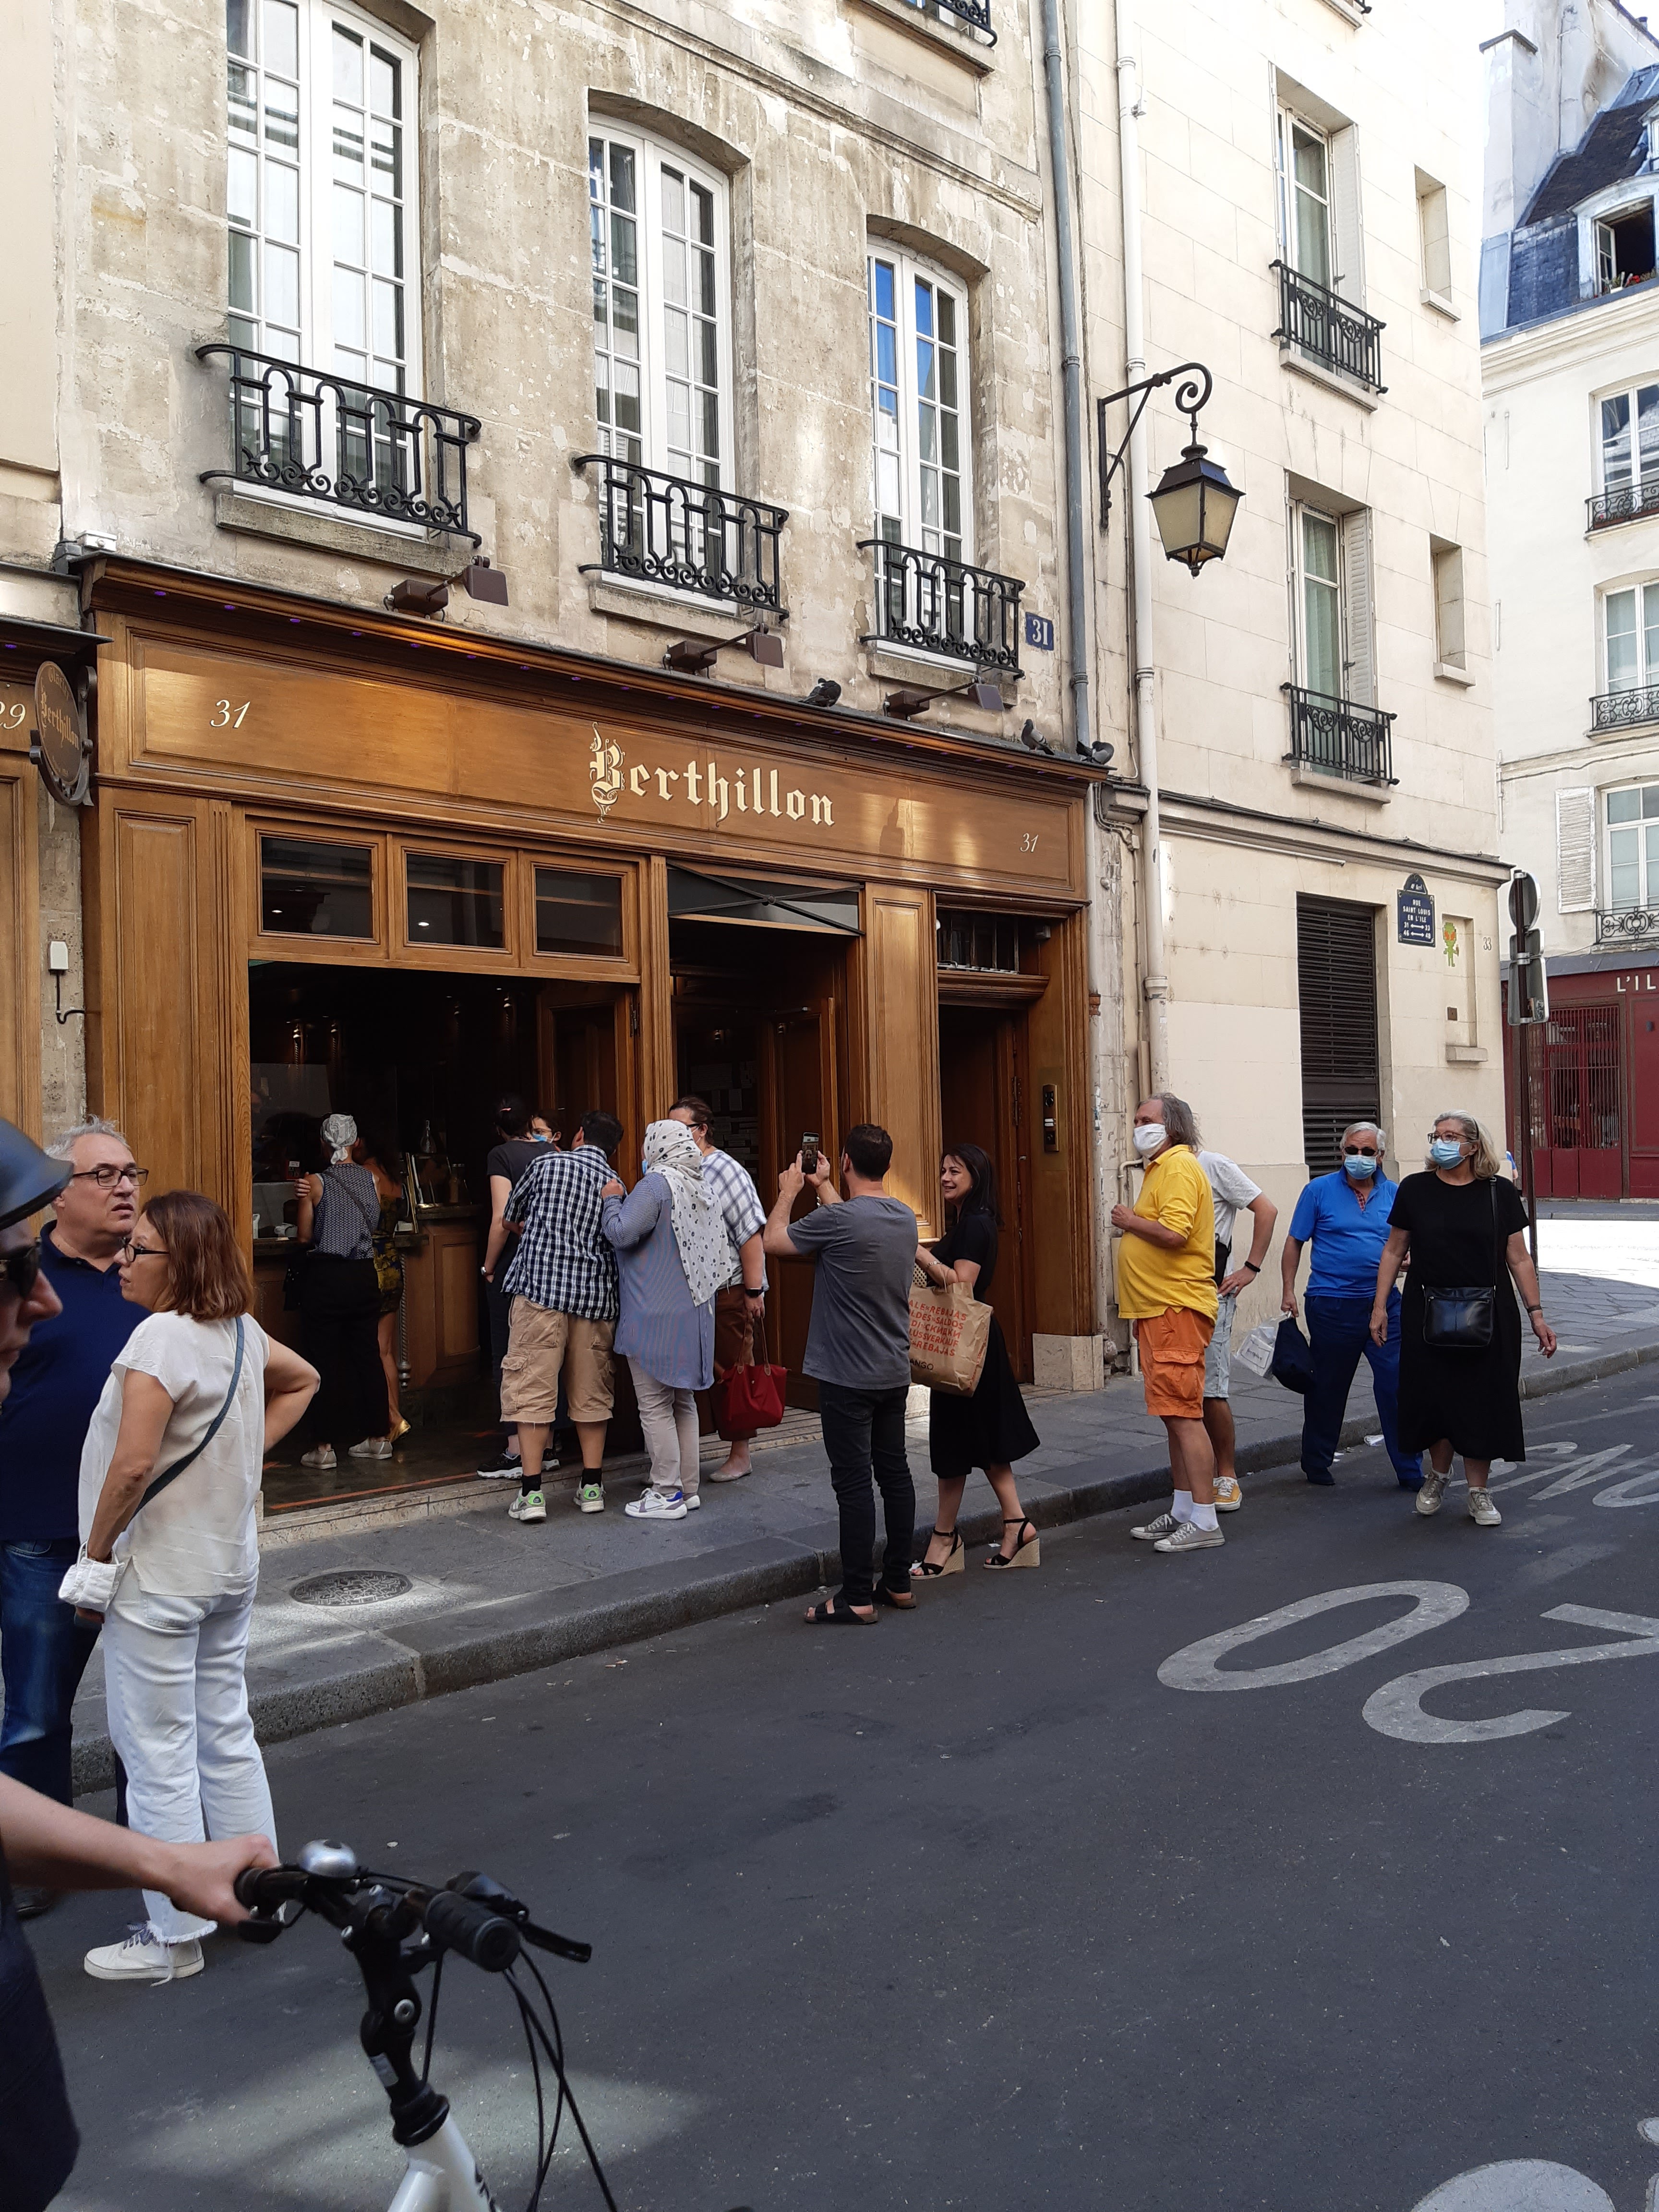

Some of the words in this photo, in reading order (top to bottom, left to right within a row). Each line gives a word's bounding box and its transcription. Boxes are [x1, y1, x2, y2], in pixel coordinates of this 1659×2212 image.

[1031, 618, 1050, 647] 31
[40, 677, 79, 750] Berthillon
[210, 699, 251, 729] 31
[589, 721, 836, 828] Berthillon
[1020, 832, 1039, 853] 31
[1483, 937, 1492, 950] 33
[909, 1299, 926, 1310] ALE
[909, 1309, 932, 1322] LDES
[936, 1317, 964, 1330] SALDOS
[909, 1329, 959, 1347] LUSSVERKAUF
[910, 1358, 934, 1370] ANGO
